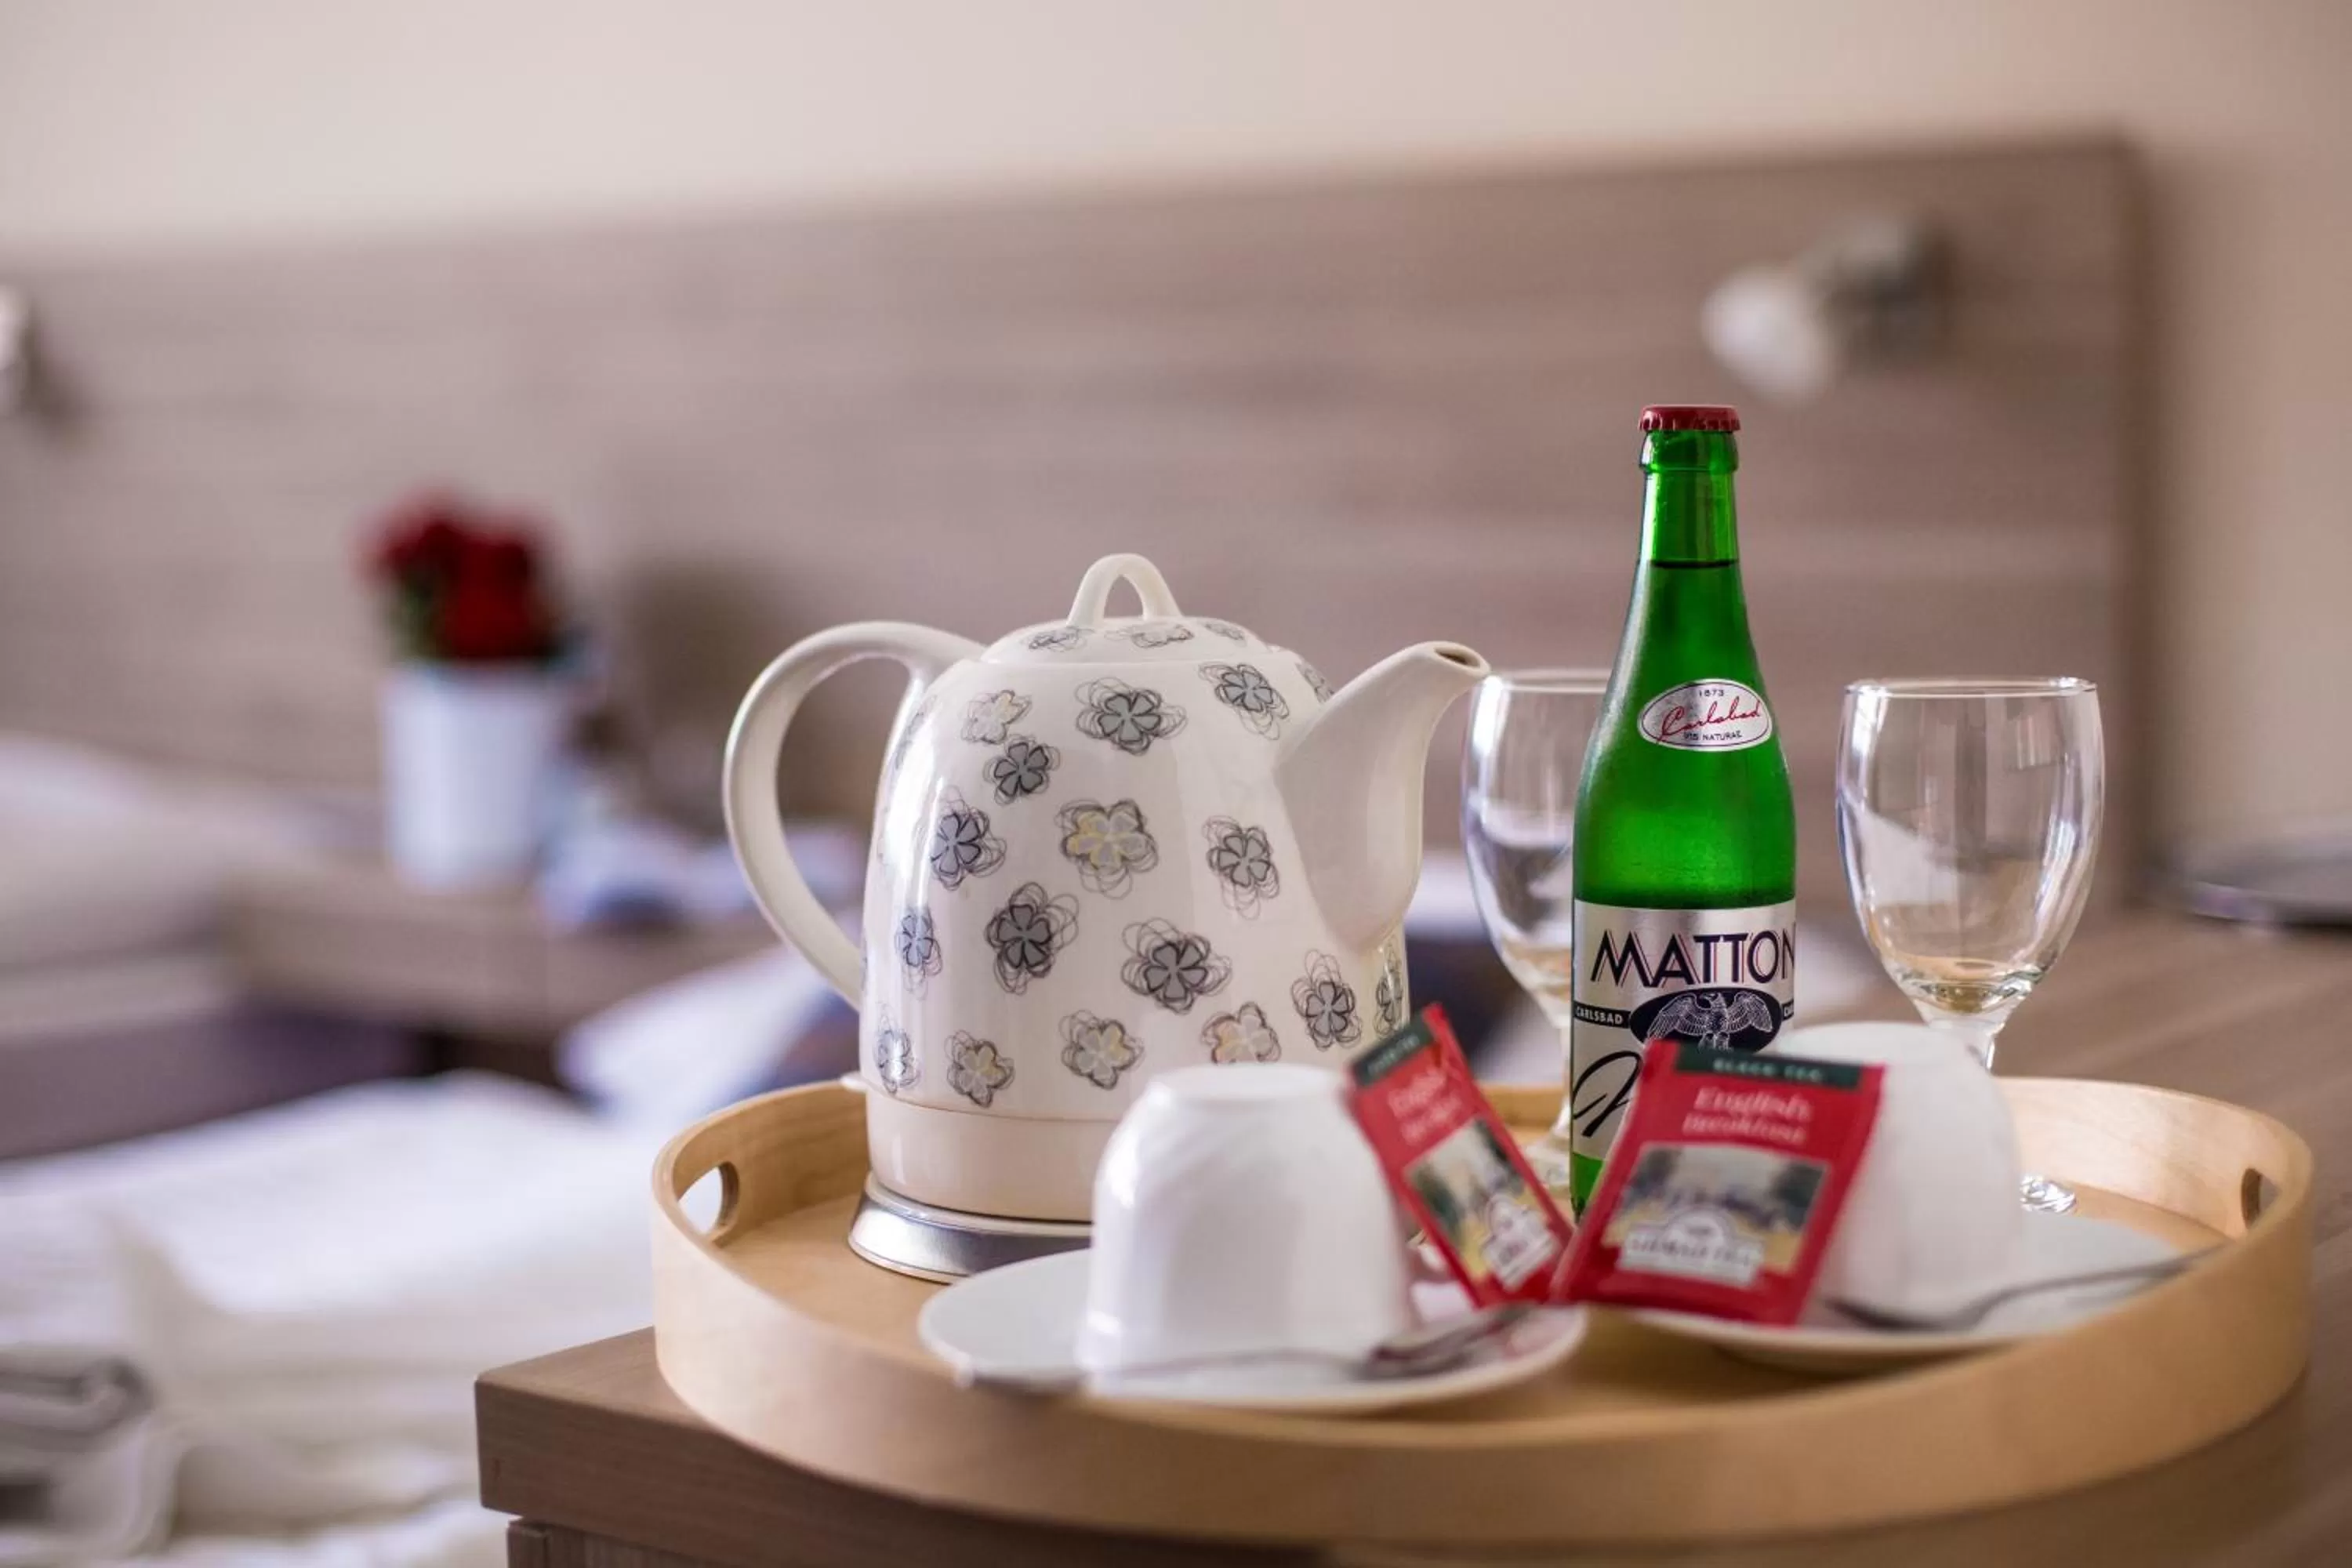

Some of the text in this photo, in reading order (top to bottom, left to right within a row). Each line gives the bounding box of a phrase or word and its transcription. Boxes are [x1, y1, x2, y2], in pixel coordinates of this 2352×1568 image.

[1702, 730, 1743, 741] NATURAE
[1575, 1006, 1624, 1025] CARLSBAD
[1784, 1064, 1823, 1082] TEA
[1693, 1087, 1812, 1122] English
